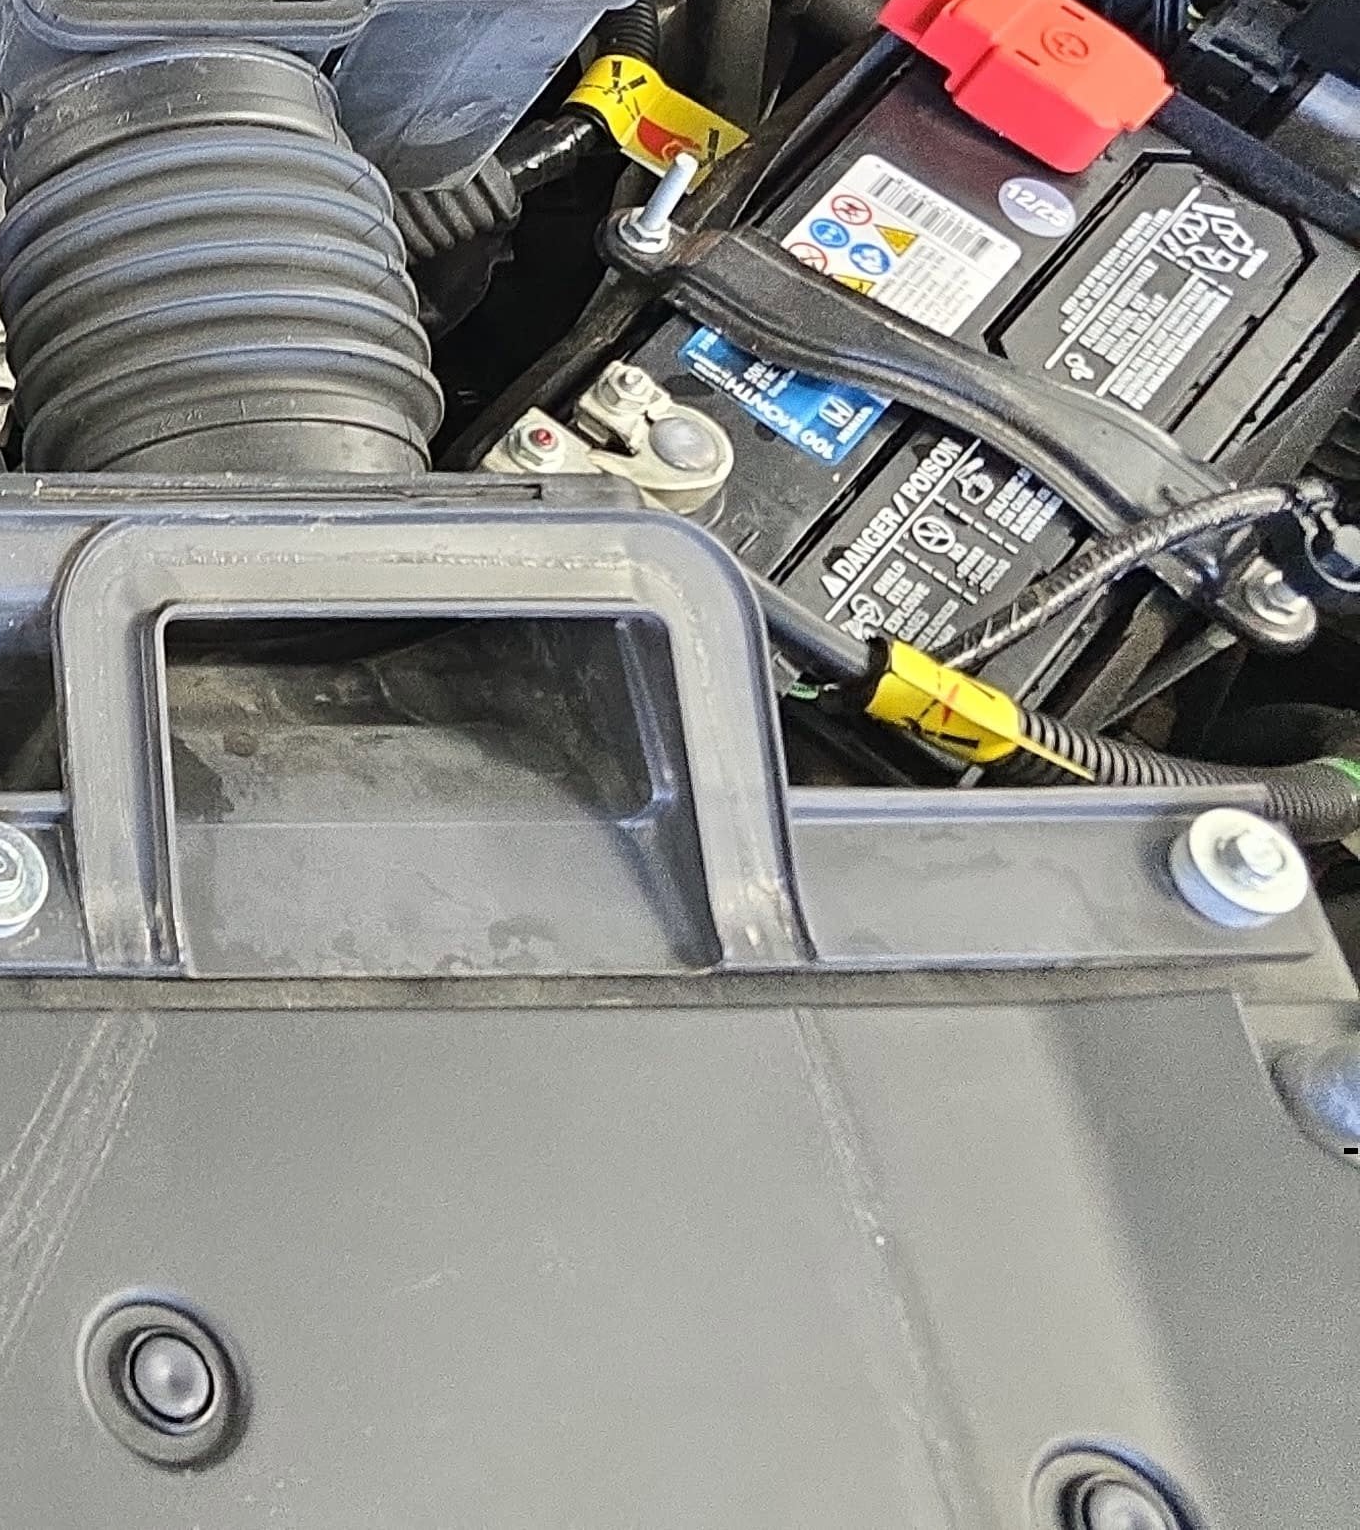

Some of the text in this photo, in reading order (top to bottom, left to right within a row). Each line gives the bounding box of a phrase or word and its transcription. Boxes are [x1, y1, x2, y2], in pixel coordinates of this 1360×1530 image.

[1004, 182, 1071, 228] 12/25
[725, 378, 805, 435] MONTH
[800, 430, 834, 458] 100
